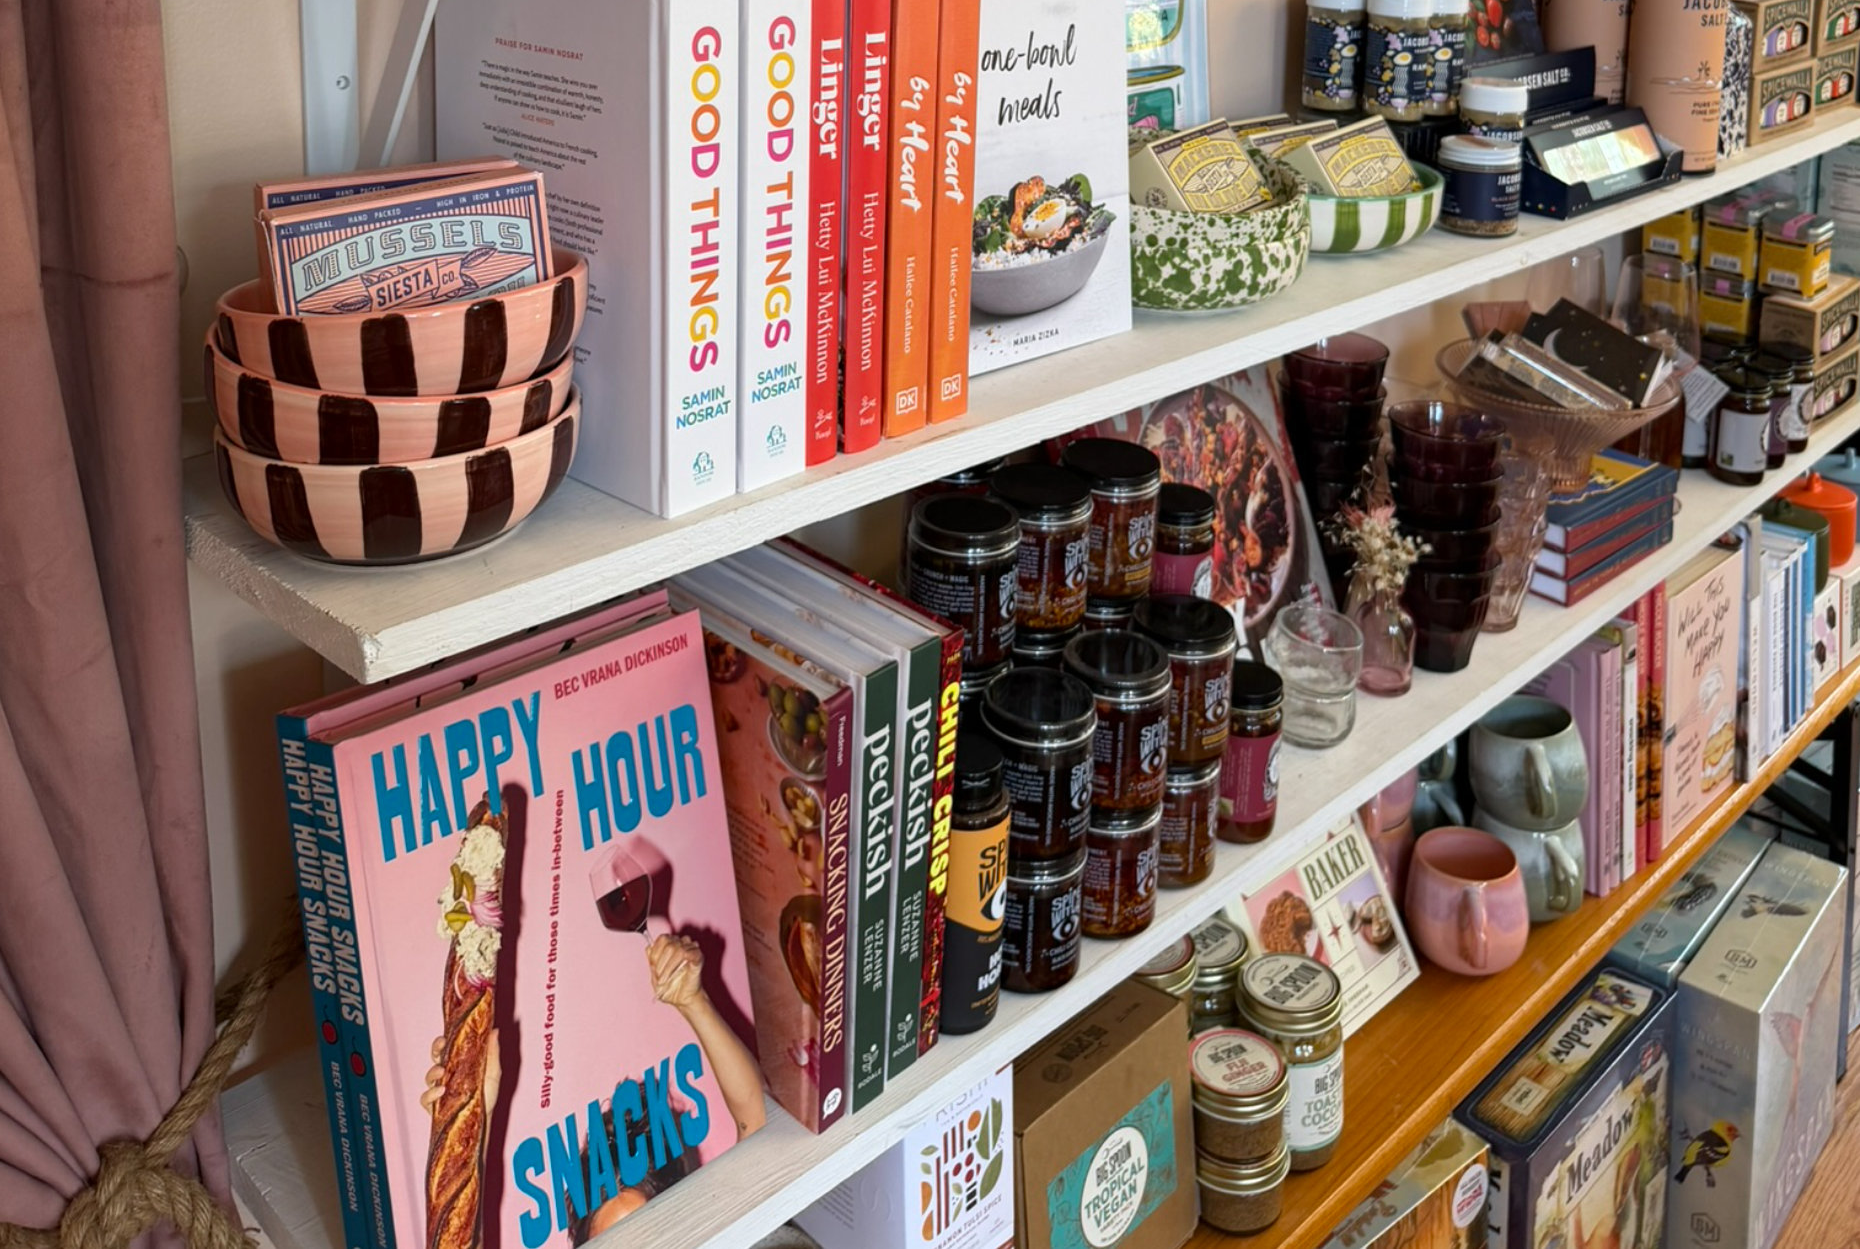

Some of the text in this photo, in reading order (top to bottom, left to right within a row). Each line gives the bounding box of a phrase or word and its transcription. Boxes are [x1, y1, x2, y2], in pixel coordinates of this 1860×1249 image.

[981, 23, 1078, 72] one-bowl
[1765, 0, 1809, 28] SPICEWALLA
[495, 37, 584, 61] PRAISE FOR SAMIN NOSRAT
[813, 38, 843, 160] Linger
[857, 31, 887, 152] Linger
[998, 77, 1063, 126] meals
[1762, 70, 1810, 97] SPICEWALLA
[899, 76, 930, 214] by Heart
[944, 71, 972, 205] by Heart
[272, 191, 322, 205] ALL NATURAL
[280, 226, 293, 236] ALL
[347, 214, 368, 224] HAND
[374, 208, 402, 219] PACKED
[436, 198, 454, 209] HIGH
[459, 196, 467, 204] IN
[472, 191, 491, 202] IRON
[495, 190, 501, 198] &
[506, 184, 535, 197] PROTEIN
[689, 25, 722, 373] GOOD THINGS
[764, 15, 796, 349] GOOD THINGS
[302, 217, 525, 292] MUSSELS
[860, 192, 879, 372] Hetty Lui McKinnon
[815, 201, 835, 384] Hetty Lui McKinnon
[904, 257, 916, 354] Hailee Catalano
[948, 247, 959, 342] Hailee Catalano
[1012, 328, 1060, 346] MARIA ZIZKA
[681, 385, 726, 411] SAMIN
[751, 375, 803, 403] NOSRAT
[757, 360, 798, 385] SAMIN
[675, 400, 731, 430] NOSRAT
[1677, 602, 1703, 638] WILL
[1704, 574, 1725, 602] THIS
[1684, 597, 1730, 656] MAKE YOU
[1692, 629, 1725, 679] HAPPY
[554, 633, 689, 700] BEC VRANA DICKINSON
[836, 715, 846, 766] Freedman
[370, 690, 544, 863] HAPPY
[571, 703, 707, 851] HOUR
[905, 696, 934, 872] peckish
[929, 681, 961, 897] CHILI CRISP
[865, 723, 895, 901] peckish
[282, 738, 337, 995] HAPPY HOUR SNACKS
[309, 762, 365, 1027] HAPPY HOUR SNACKS
[1303, 833, 1365, 901] BAKER
[541, 789, 564, 1109] Silly-good food for those times in-between
[823, 792, 848, 1054] SNACKING DINNERS
[863, 926, 873, 985] LENZER
[872, 918, 885, 992] SUZANNE
[900, 897, 911, 954] LENZER
[909, 890, 922, 963] SUZANNE
[1550, 1006, 1613, 1063] Meadow
[1679, 1021, 1751, 1060] WINGSPAN
[1222, 1061, 1267, 1082] GINGER
[330, 1061, 359, 1212] BEC VRANA DICKINSON
[512, 1041, 712, 1249] SNACKS
[1095, 1140, 1132, 1188] BIG SPOON
[1565, 1099, 1634, 1205] Meadow
[359, 1093, 387, 1249] BEC VRANA DICKINSON
[1083, 1156, 1145, 1220] TROPICAL
[1093, 1179, 1137, 1229] VEGAN
